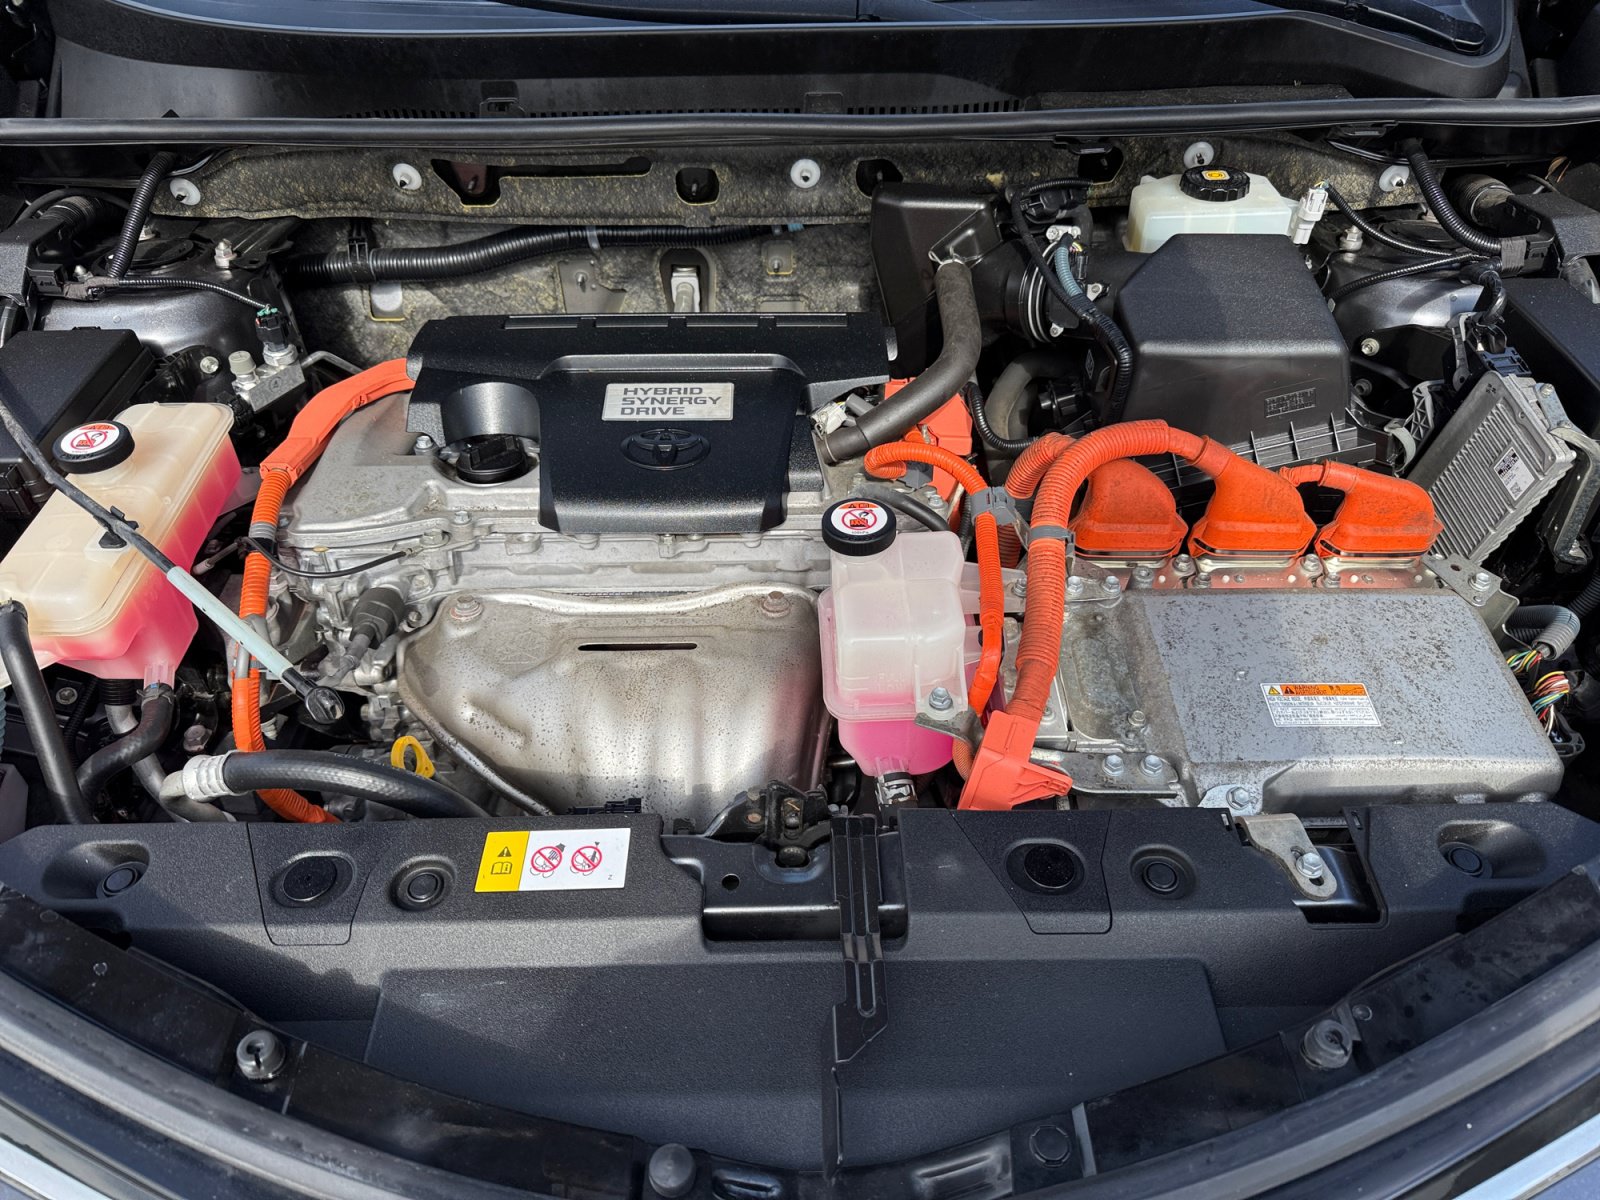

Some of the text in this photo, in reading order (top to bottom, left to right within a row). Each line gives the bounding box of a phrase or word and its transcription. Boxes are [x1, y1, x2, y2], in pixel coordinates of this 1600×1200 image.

[623, 387, 703, 395] HYBRID
[621, 396, 722, 405] SYNERGY
[620, 406, 685, 415] DRIVE
